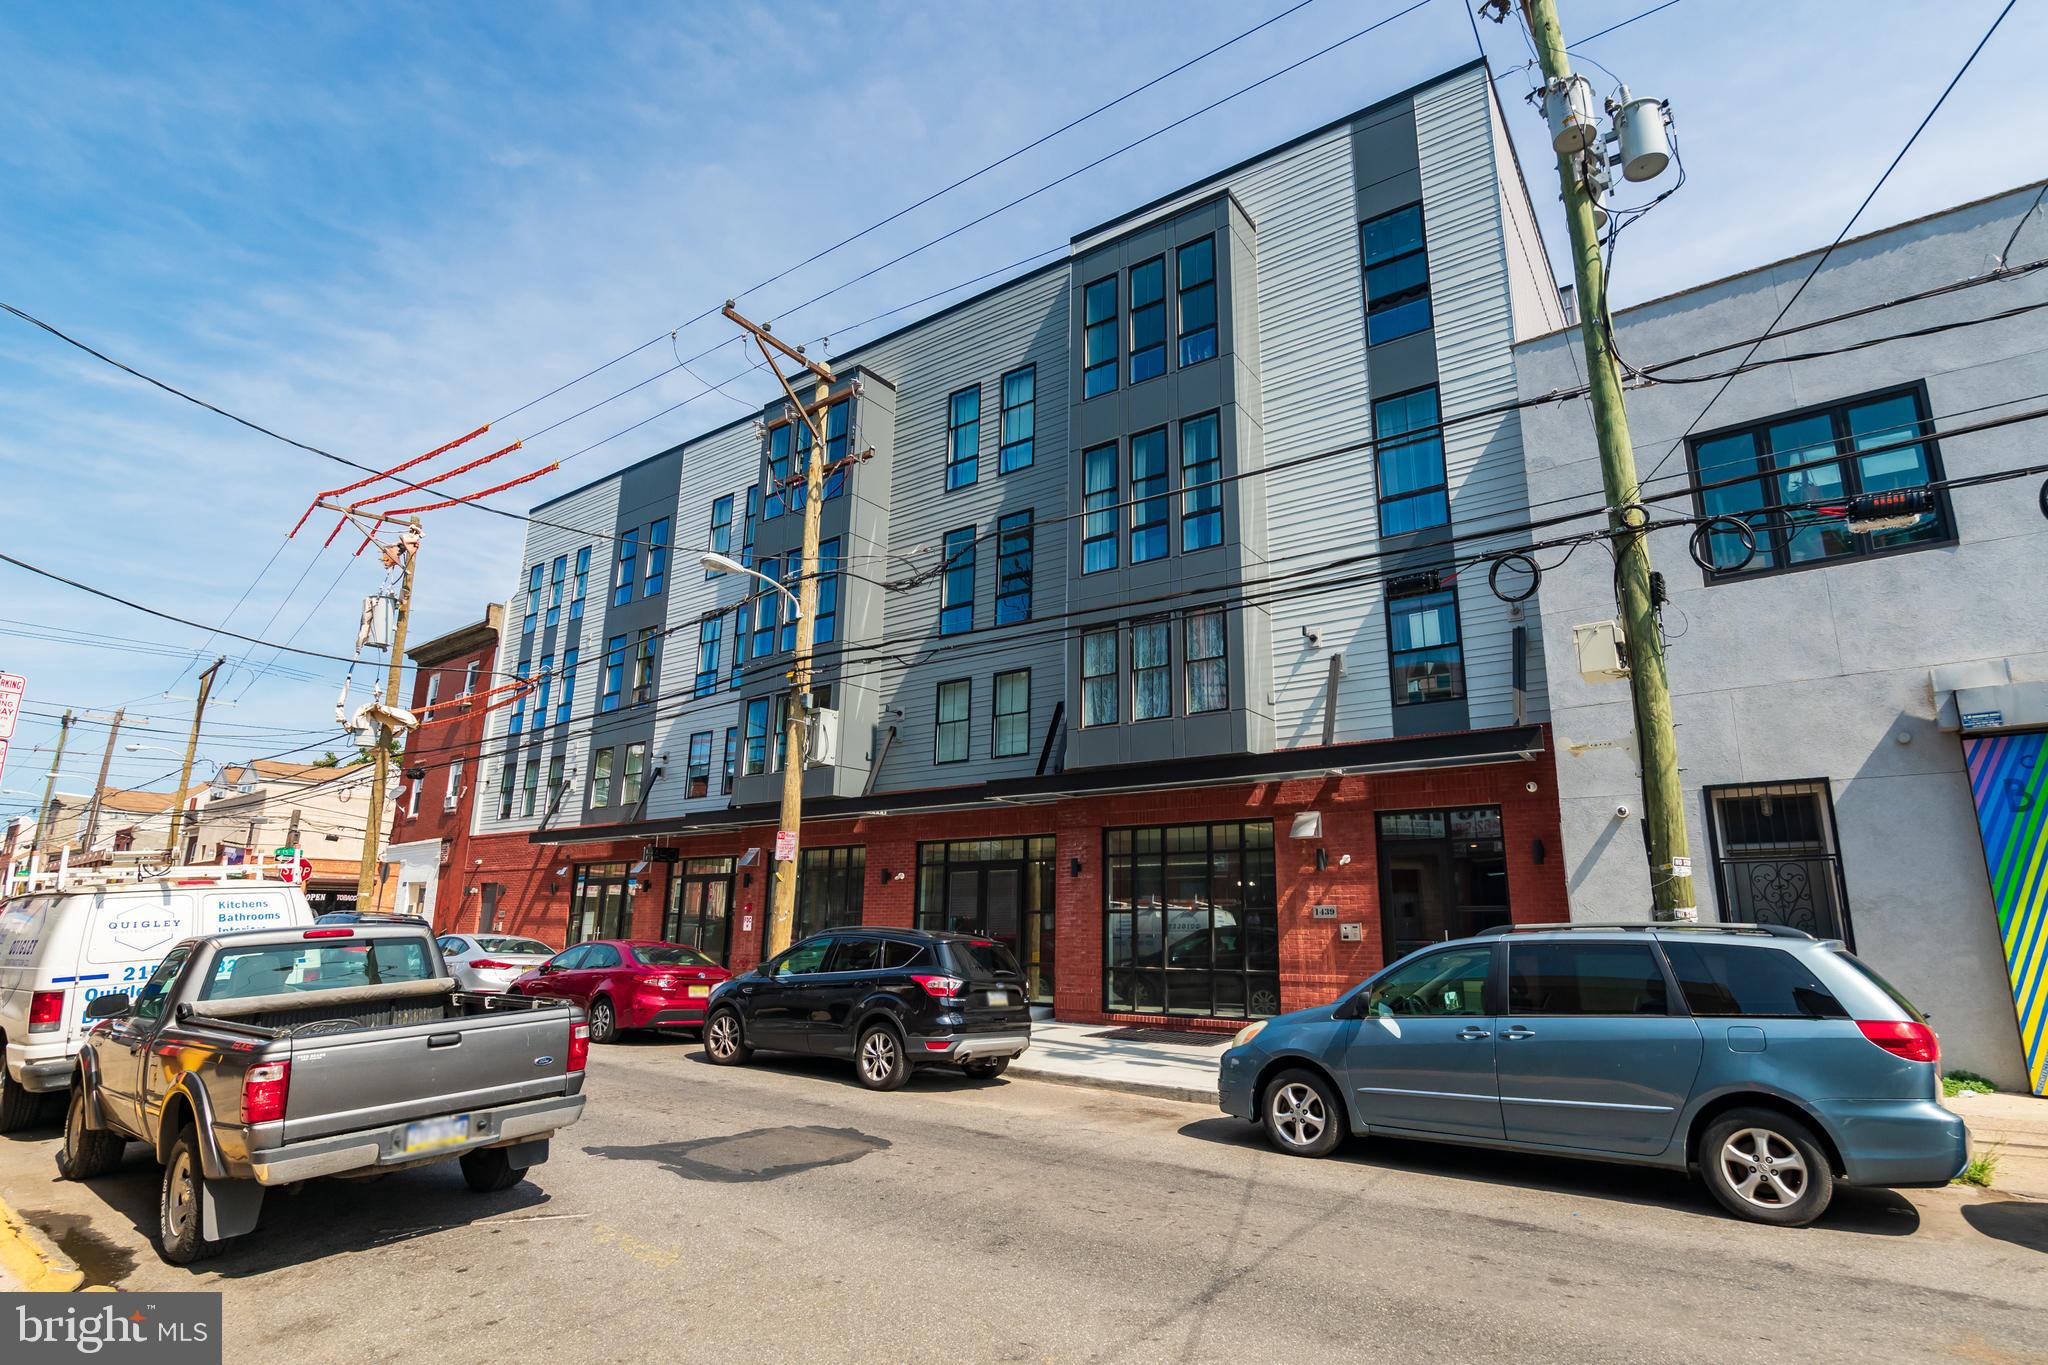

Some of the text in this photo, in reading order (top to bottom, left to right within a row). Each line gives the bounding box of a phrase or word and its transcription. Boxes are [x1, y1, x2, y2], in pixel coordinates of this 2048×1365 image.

[282, 866, 311, 877] SP
[218, 900, 268, 910] Kitchens
[218, 912, 281, 922] Bathrooms
[1315, 908, 1335, 916] 1439
[108, 920, 180, 929] QUIGLEY
